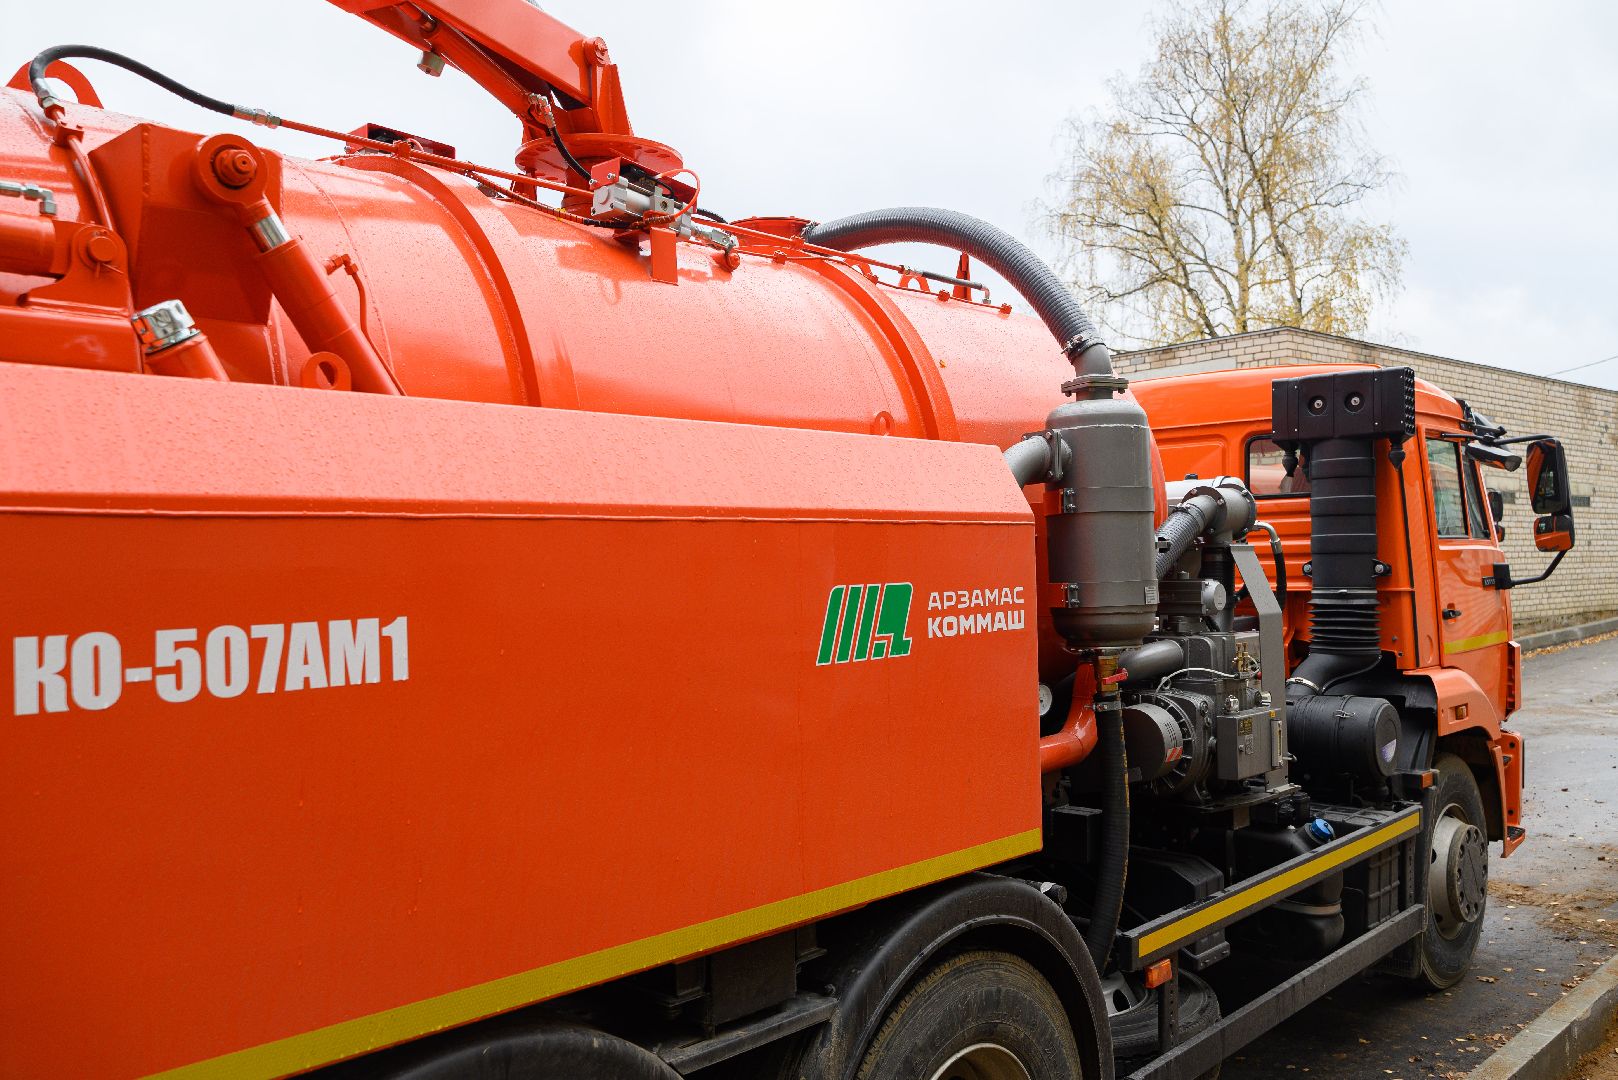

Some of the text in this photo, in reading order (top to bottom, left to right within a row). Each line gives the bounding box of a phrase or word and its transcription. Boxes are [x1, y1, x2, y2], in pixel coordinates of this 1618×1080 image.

[927, 586, 1025, 610] АРЗАМАС
[927, 609, 1025, 639] КОММАШ
[13, 616, 409, 716] КО-507АМ1
